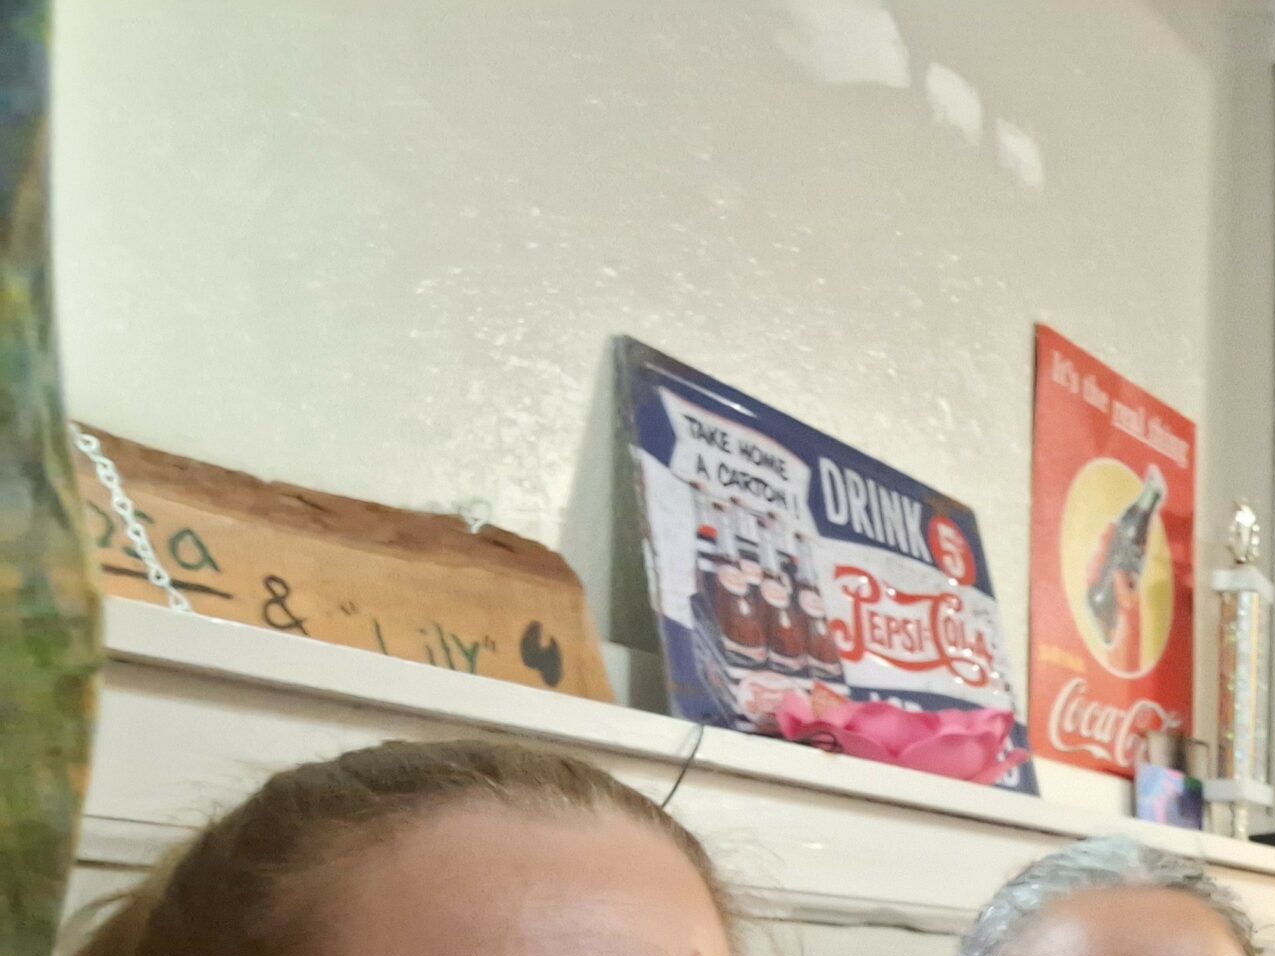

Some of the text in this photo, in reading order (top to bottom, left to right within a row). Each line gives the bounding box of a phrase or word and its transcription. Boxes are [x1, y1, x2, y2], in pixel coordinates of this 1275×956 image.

[1083, 374, 1109, 415] the
[682, 414, 788, 481] TAKE HOME
[696, 453, 710, 480] A
[819, 456, 934, 563] DRINK
[263, 575, 309, 637] &
